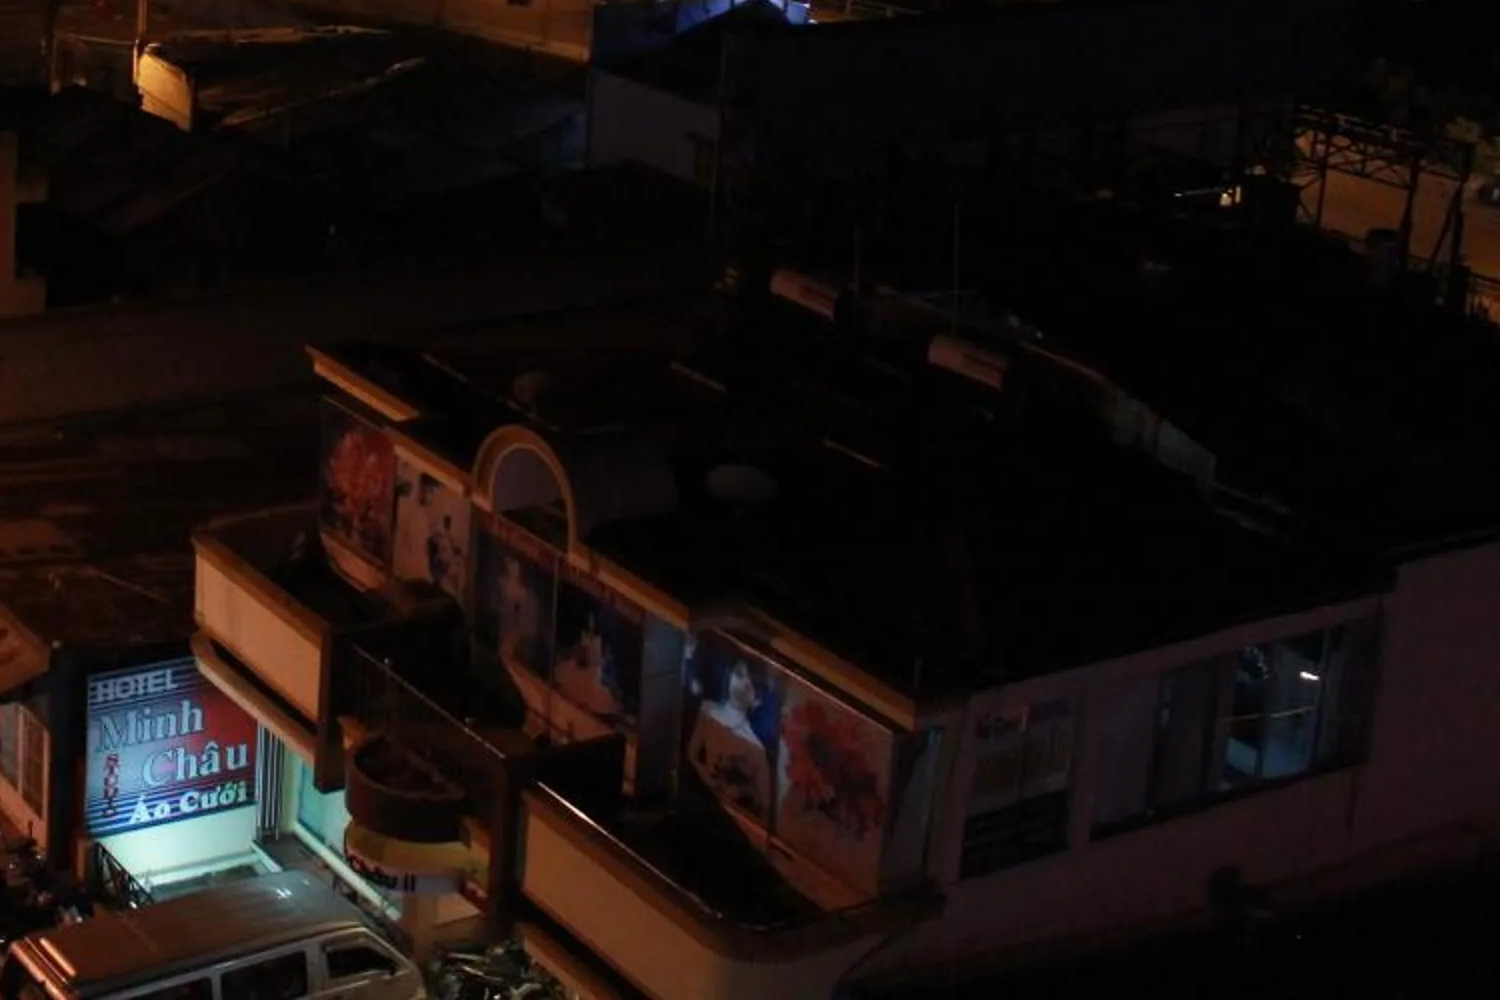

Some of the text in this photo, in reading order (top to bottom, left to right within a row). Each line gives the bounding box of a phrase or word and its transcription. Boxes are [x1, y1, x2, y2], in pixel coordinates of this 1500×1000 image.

[96, 669, 179, 702] HOTEL
[96, 699, 205, 753] Minh
[142, 740, 249, 787] Châu
[130, 780, 249, 824] Áo Cưới
